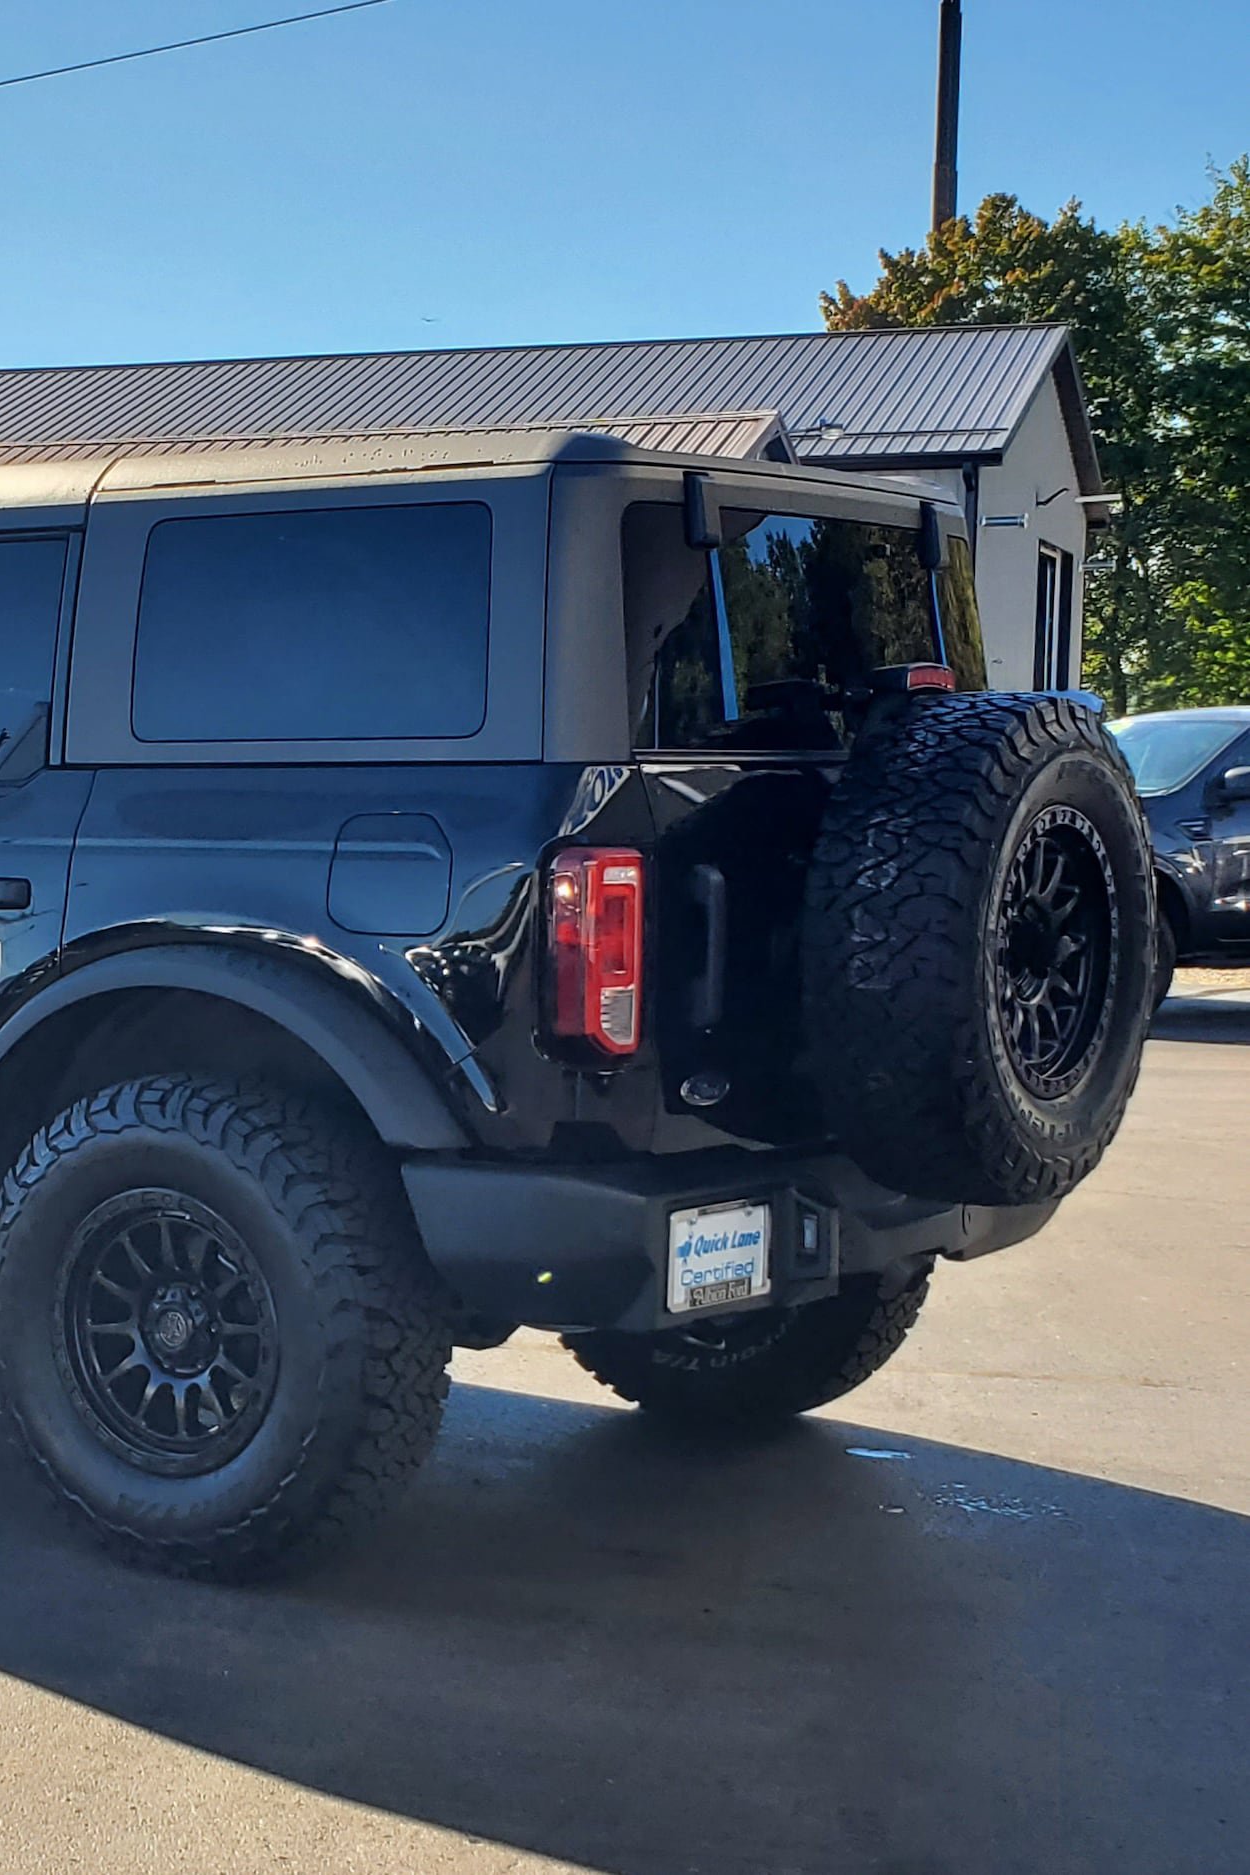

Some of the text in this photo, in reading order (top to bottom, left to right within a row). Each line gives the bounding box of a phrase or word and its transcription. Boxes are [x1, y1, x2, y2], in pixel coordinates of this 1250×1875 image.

[694, 1230, 760, 1256] Quick Lane
[681, 1258, 754, 1285] Certified
